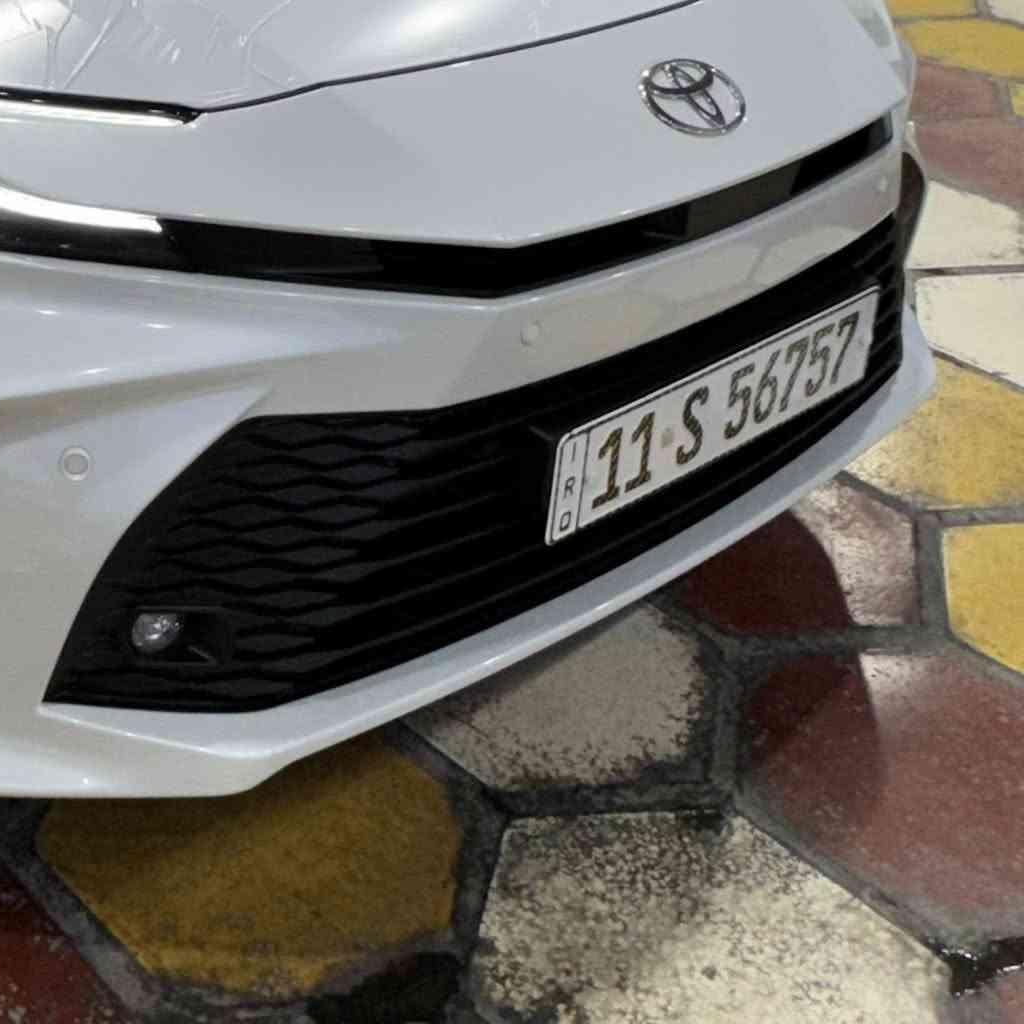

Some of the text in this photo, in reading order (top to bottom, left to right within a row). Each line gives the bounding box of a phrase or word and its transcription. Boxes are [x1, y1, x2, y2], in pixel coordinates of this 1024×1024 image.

[592, 311, 860, 510] 11 S 56757
